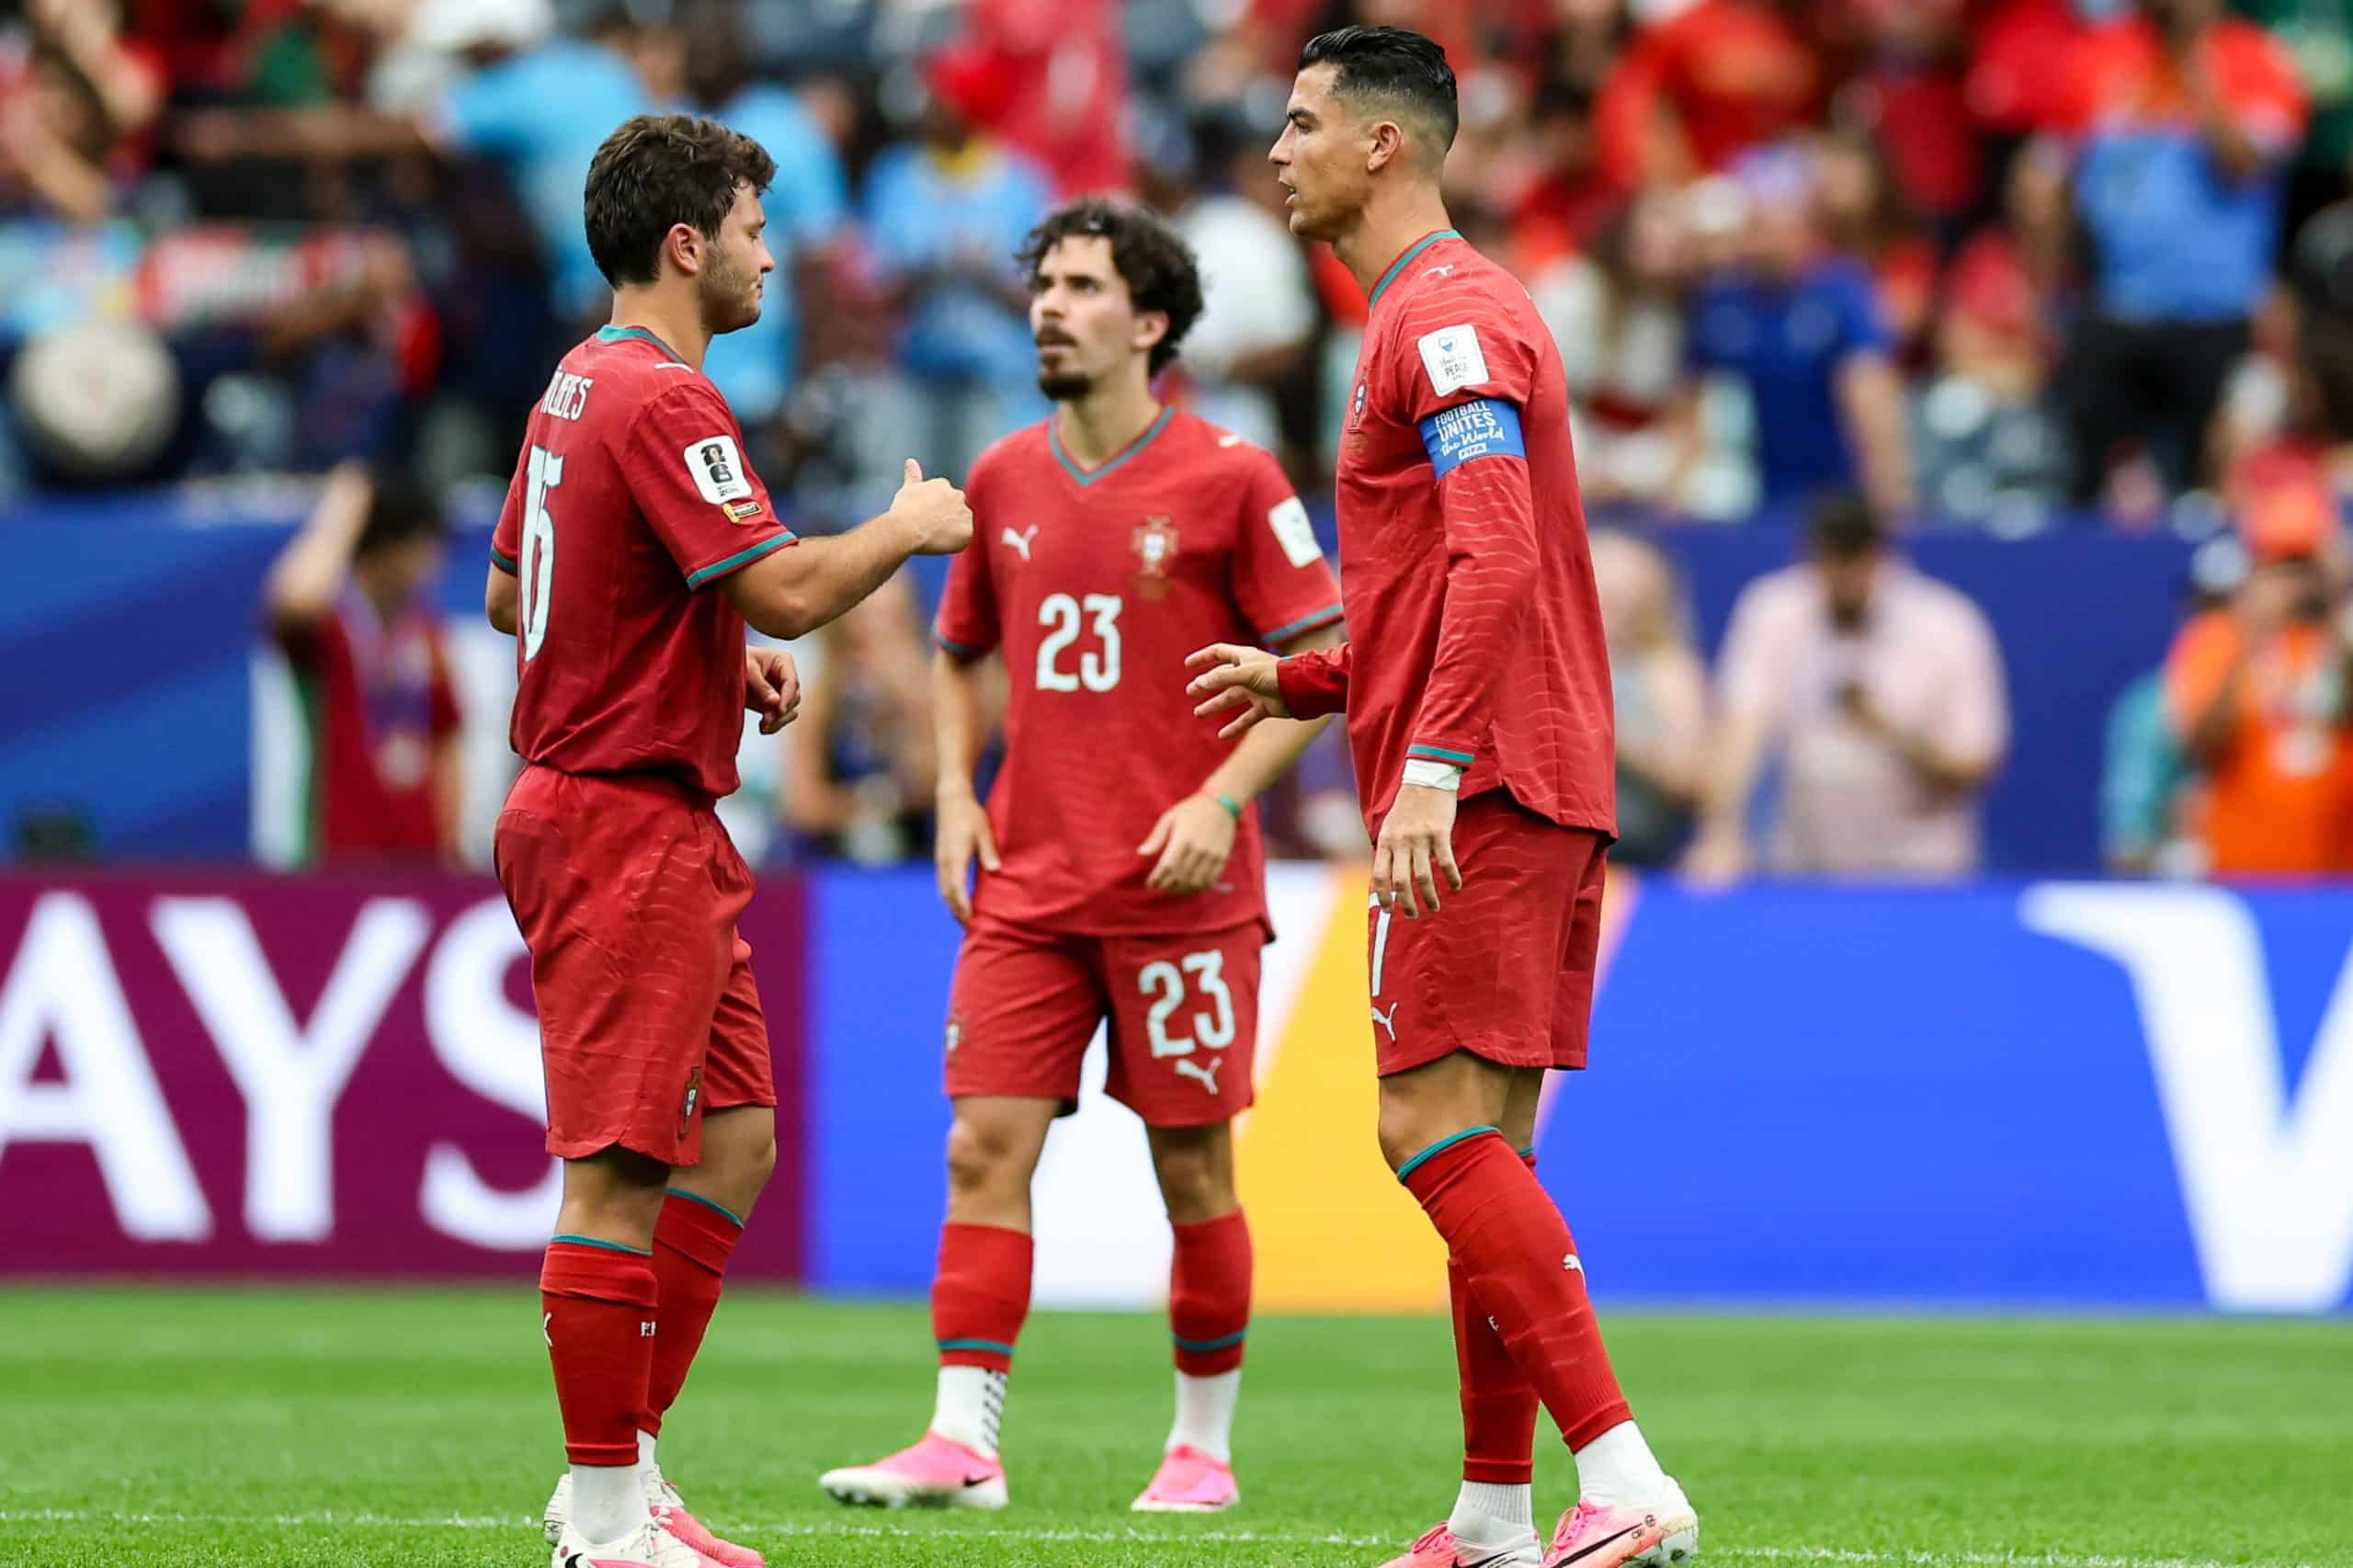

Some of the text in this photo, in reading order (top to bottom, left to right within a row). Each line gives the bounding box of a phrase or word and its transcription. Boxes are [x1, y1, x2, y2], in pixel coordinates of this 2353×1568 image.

[1435, 401, 1490, 428] FOOTBALL
[1438, 411, 1496, 441] UNITES
[1461, 426, 1505, 446] World
[1036, 593, 1122, 692] 23
[1139, 949, 1235, 1058] 23
[0, 890, 563, 1251] AYS
